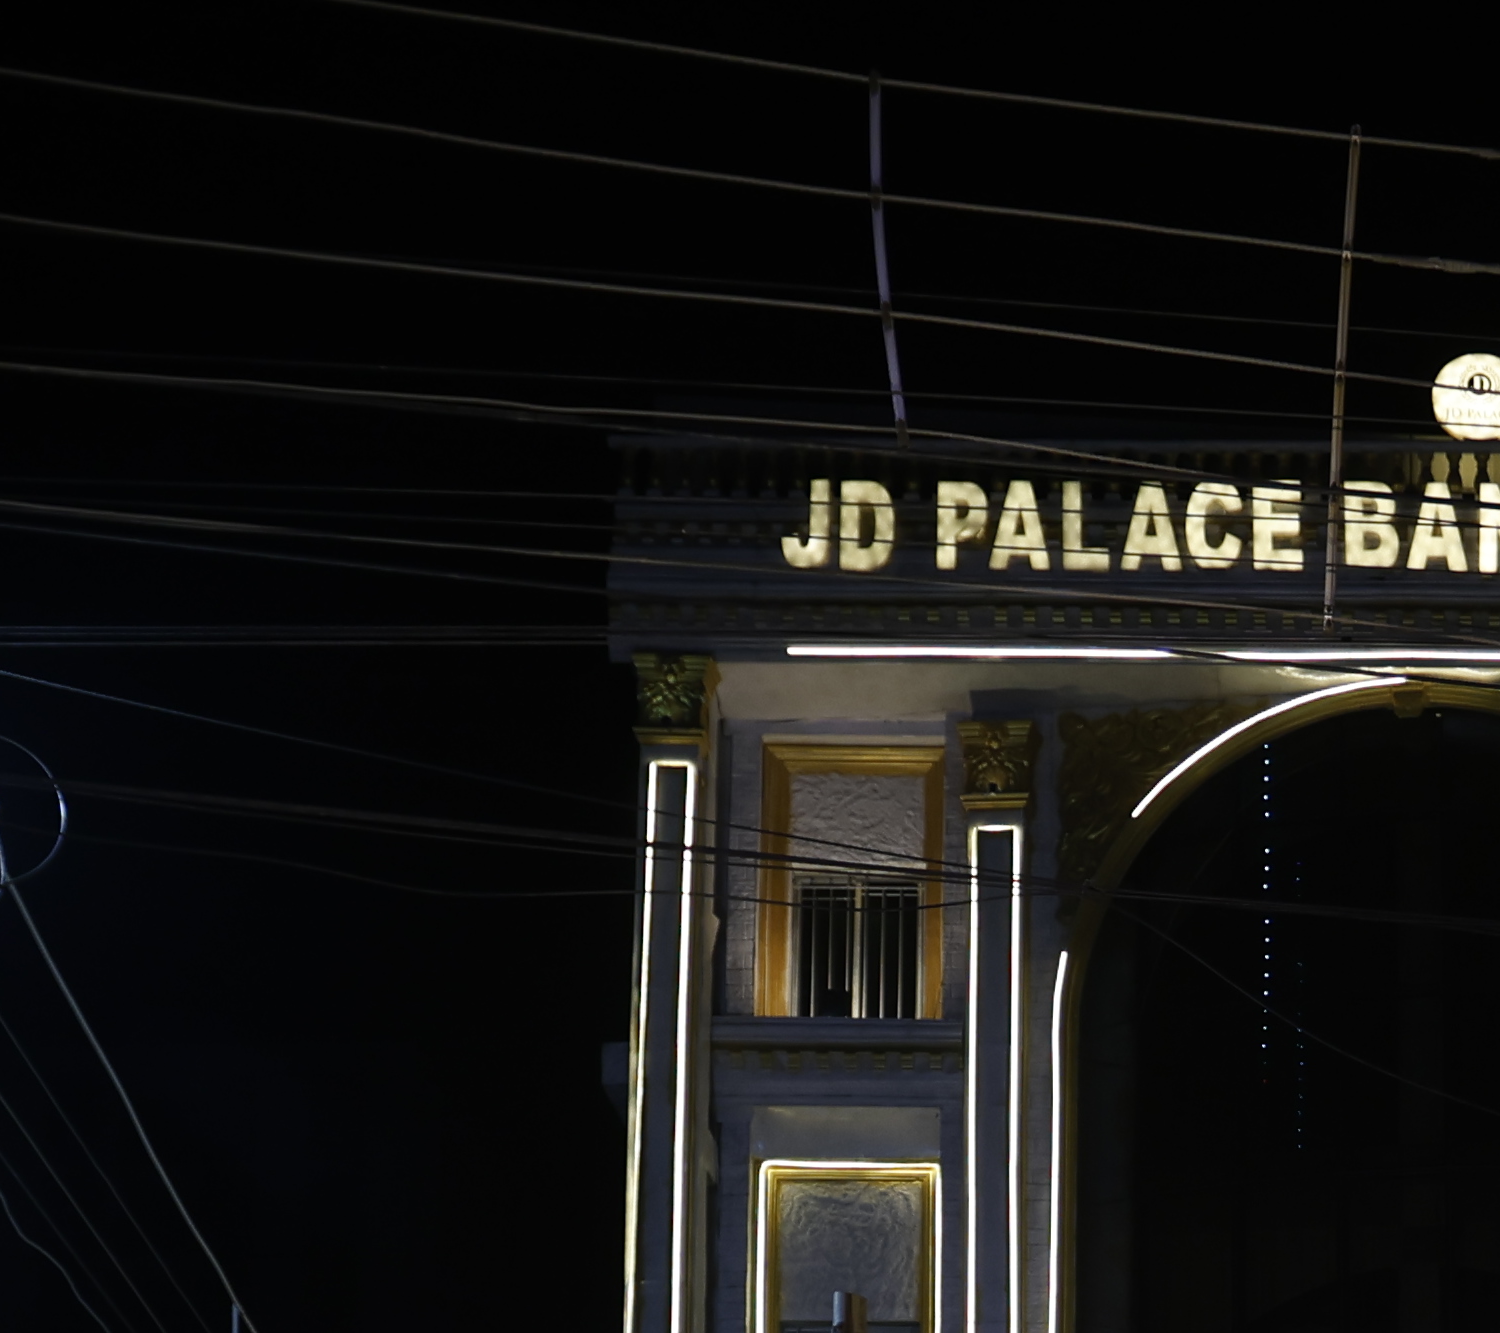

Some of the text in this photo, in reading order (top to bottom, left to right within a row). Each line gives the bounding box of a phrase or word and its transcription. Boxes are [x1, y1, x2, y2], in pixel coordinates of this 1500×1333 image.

[1445, 408, 1462, 420] JD
[781, 478, 895, 571] JD
[935, 478, 1305, 572] PALACE
